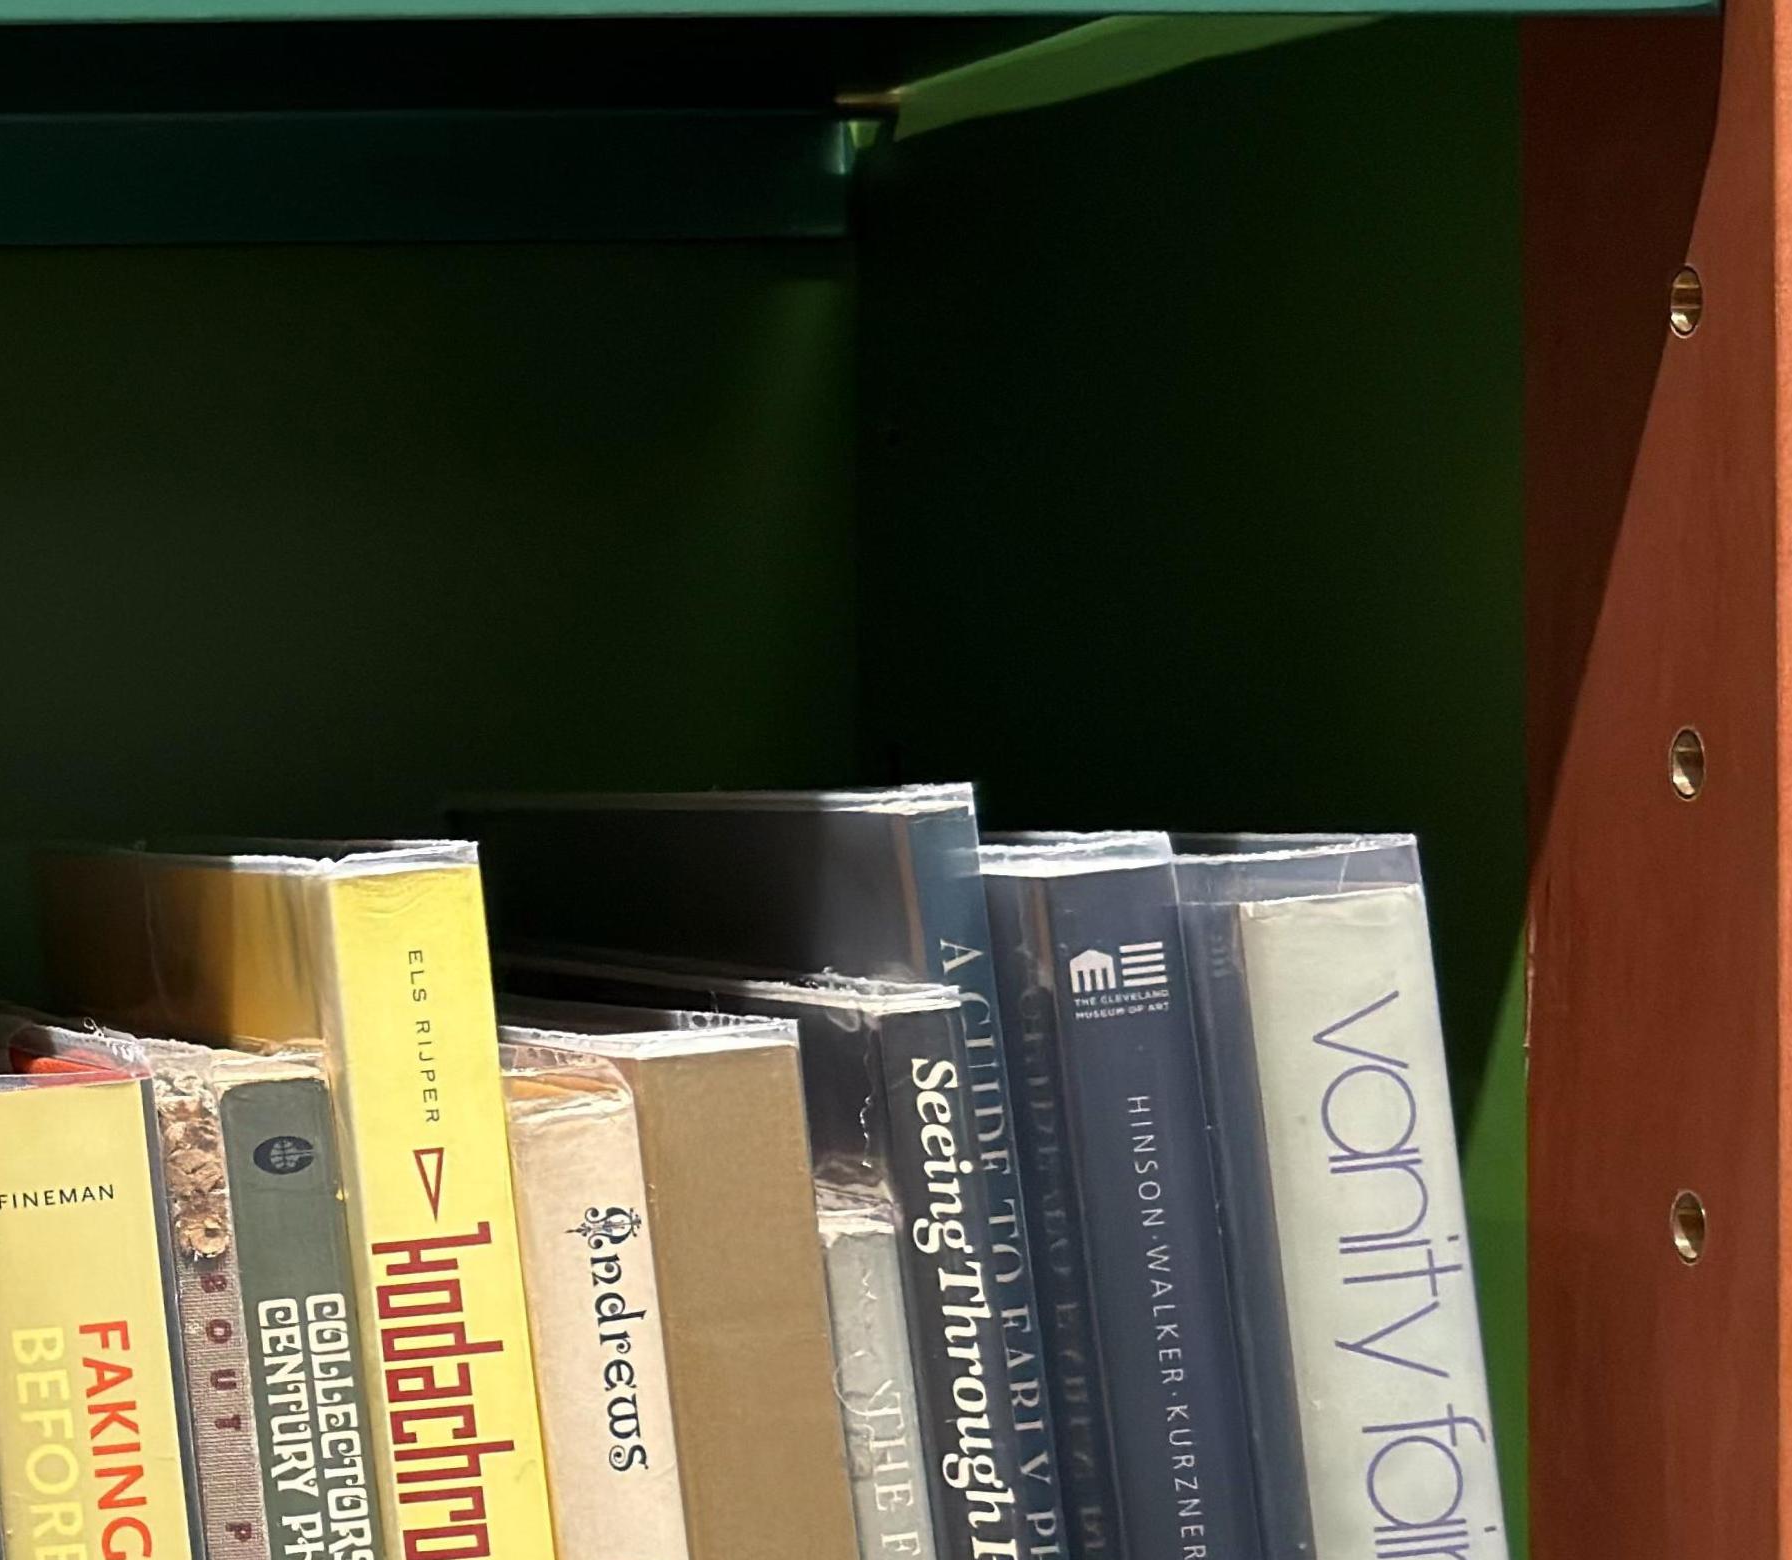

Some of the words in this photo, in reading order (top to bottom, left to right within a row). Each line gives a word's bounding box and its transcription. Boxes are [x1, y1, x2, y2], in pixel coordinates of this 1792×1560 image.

[407, 949, 427, 1004] ELS
[1075, 1007, 1125, 1020] MUSEUM
[1148, 1002, 1169, 1012] ART
[1100, 990, 1169, 1004] CLEVELAND
[416, 1019, 441, 1125] RIJPER
[911, 1056, 974, 1254] Seeing
[258, 1297, 320, 1498] CENTURY
[941, 1260, 1017, 1530] Through
